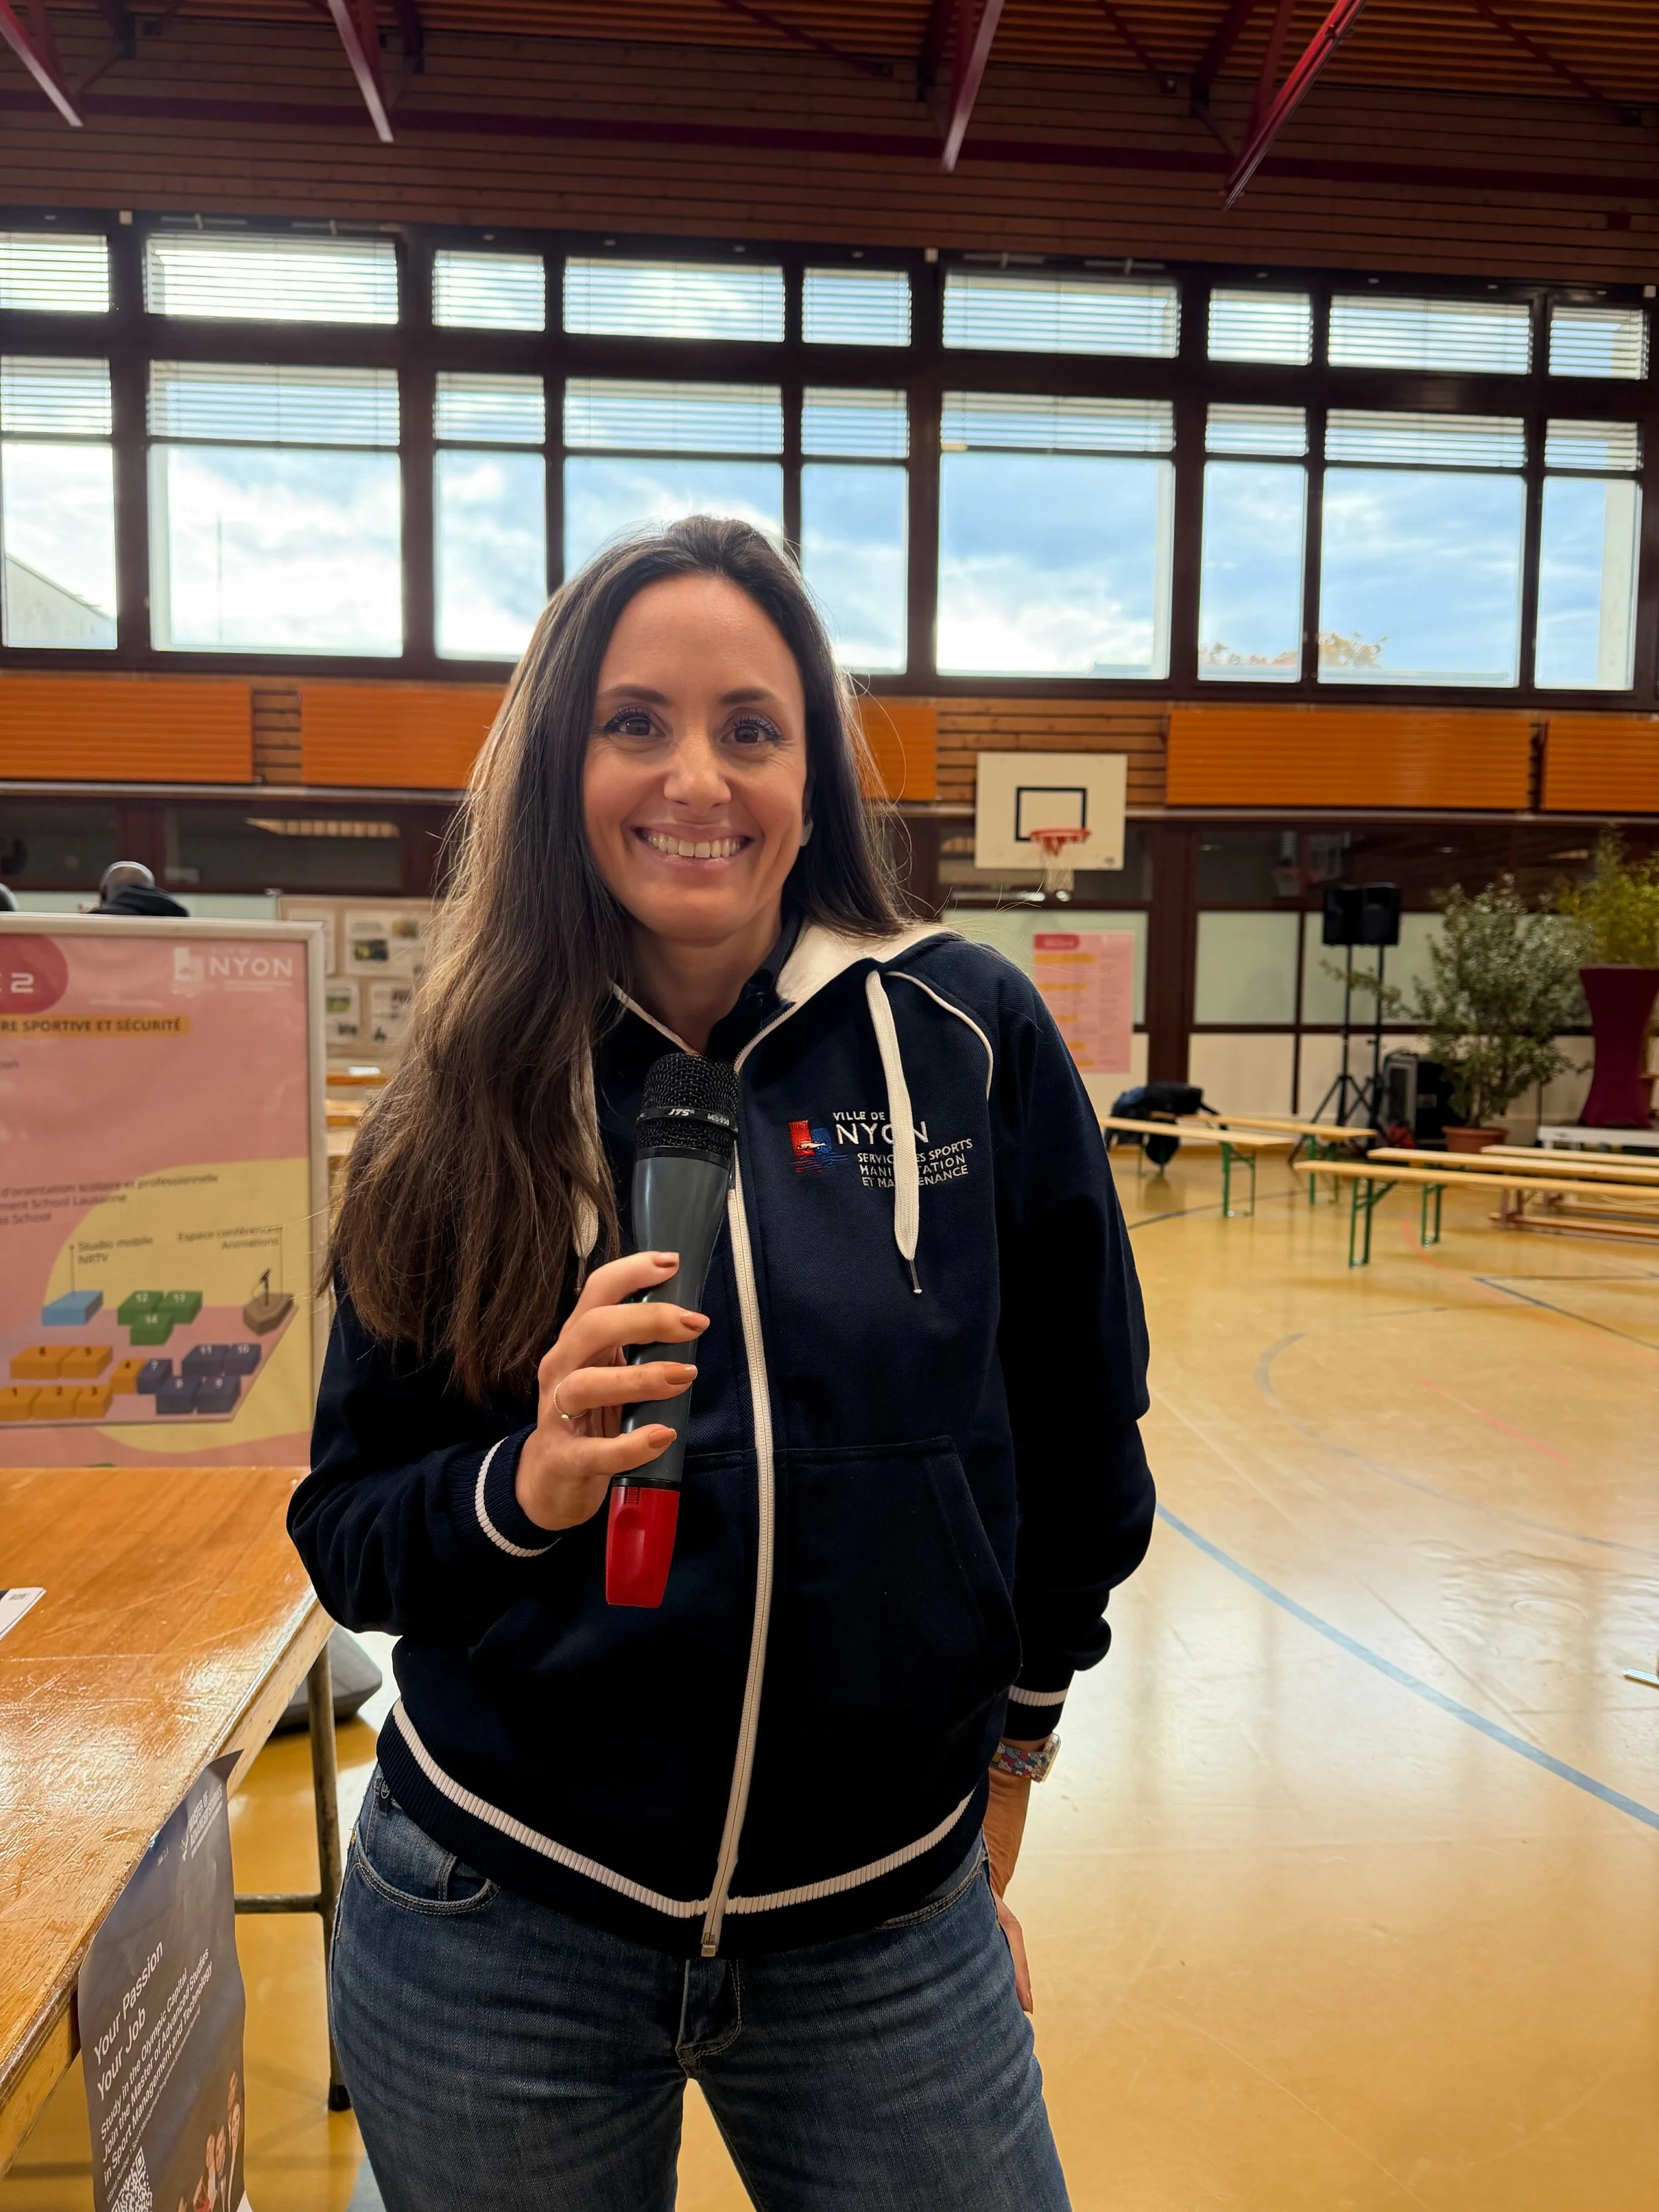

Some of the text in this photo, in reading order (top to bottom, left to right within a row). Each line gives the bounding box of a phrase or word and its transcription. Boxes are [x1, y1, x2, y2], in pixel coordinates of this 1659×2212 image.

[209, 956, 293, 977] NYON
[10, 972, 35, 994] 2
[23, 1019, 91, 1033] SPORTIVE
[97, 1019, 111, 1032] ET
[117, 1017, 181, 1032] SÉCURITÉ
[833, 1111, 885, 1121] VILLE DE
[857, 1153, 894, 1164] SERVIC
[929, 1138, 973, 1161] SPORTS
[138, 1173, 219, 1189] professionnelle
[862, 1177, 875, 1187] ET
[31, 1197, 70, 1210] School
[12, 1211, 52, 1225] School
[78, 1236, 154, 1253] Studio mobile
[177, 1231, 214, 1243] Espace
[221, 1237, 280, 1250] Animations
[94, 1941, 163, 2066] Your Passion
[97, 2007, 146, 2101] Your Job
[101, 1967, 187, 2141] Study in the Olympic Capital
[103, 2128, 119, 2164] Join
[119, 2103, 131, 2130] the
[131, 2057, 153, 2108] Master
[154, 2039, 162, 2063] of
[161, 1984, 190, 2049] Advanced
[189, 1948, 209, 1989] Studies
[104, 2166, 111, 2187] in
[111, 2124, 132, 2170] Sport
[132, 2046, 173, 2130] Management
[171, 2019, 184, 2051] and
[182, 1960, 212, 2027] Technology
